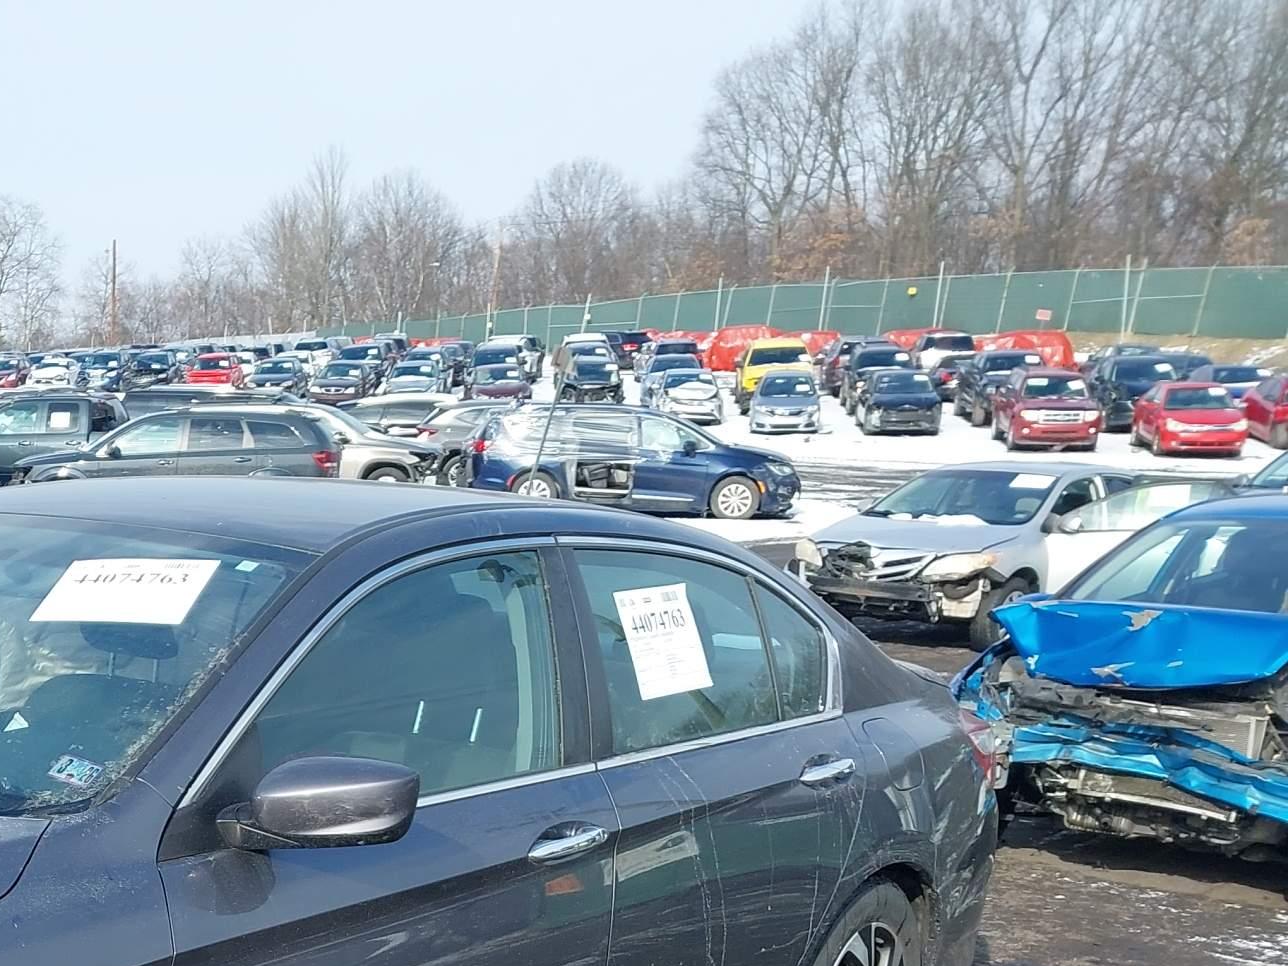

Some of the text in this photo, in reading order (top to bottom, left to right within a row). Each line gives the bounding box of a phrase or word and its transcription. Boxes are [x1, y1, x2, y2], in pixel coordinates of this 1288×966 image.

[73, 573, 189, 584] 44074763
[631, 608, 686, 633] 44074763
[56, 758, 74, 773] 3
